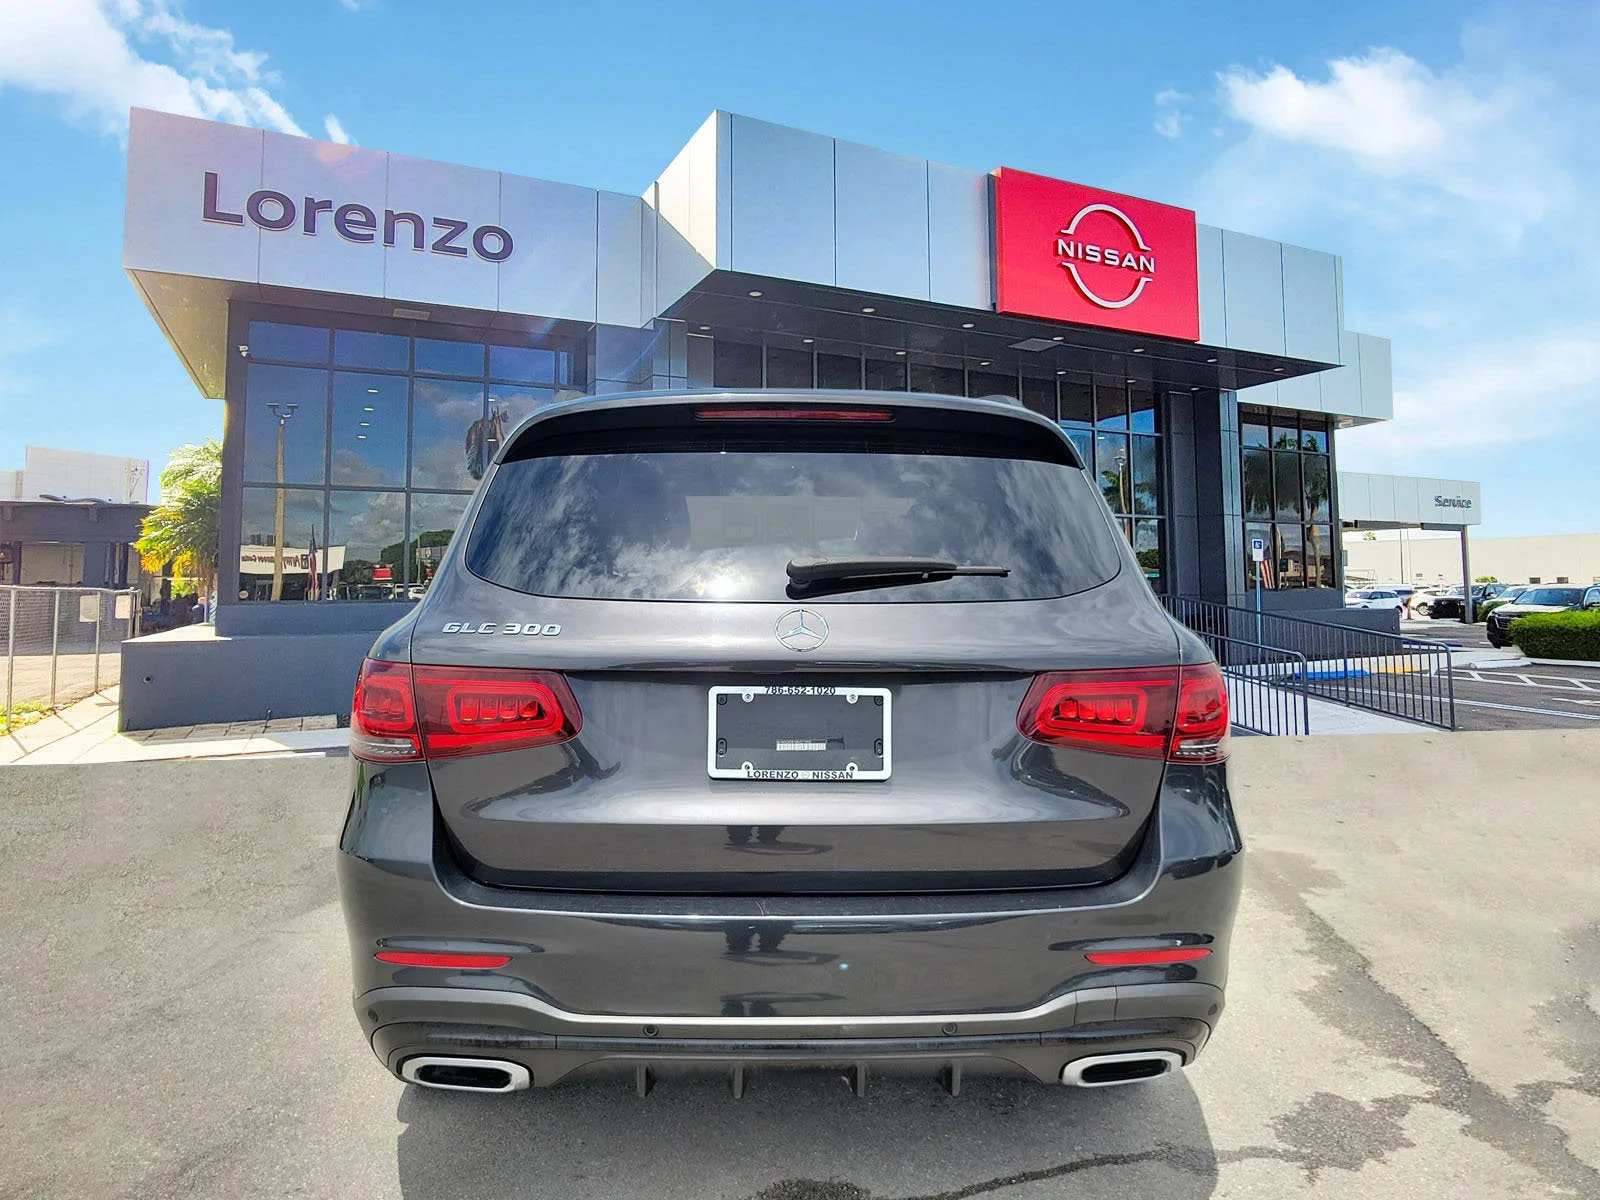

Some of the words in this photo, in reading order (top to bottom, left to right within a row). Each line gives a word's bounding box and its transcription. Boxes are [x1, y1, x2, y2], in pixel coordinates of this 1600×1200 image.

[202, 171, 514, 263] Lorenzo
[1057, 238, 1155, 273] NISSAN
[1434, 495, 1472, 509] Service
[442, 622, 497, 635] GLC
[502, 623, 561, 636] 300
[765, 685, 836, 696] 786-652-1020
[747, 770, 799, 779] LORENZO
[812, 771, 853, 779] NISSAN
